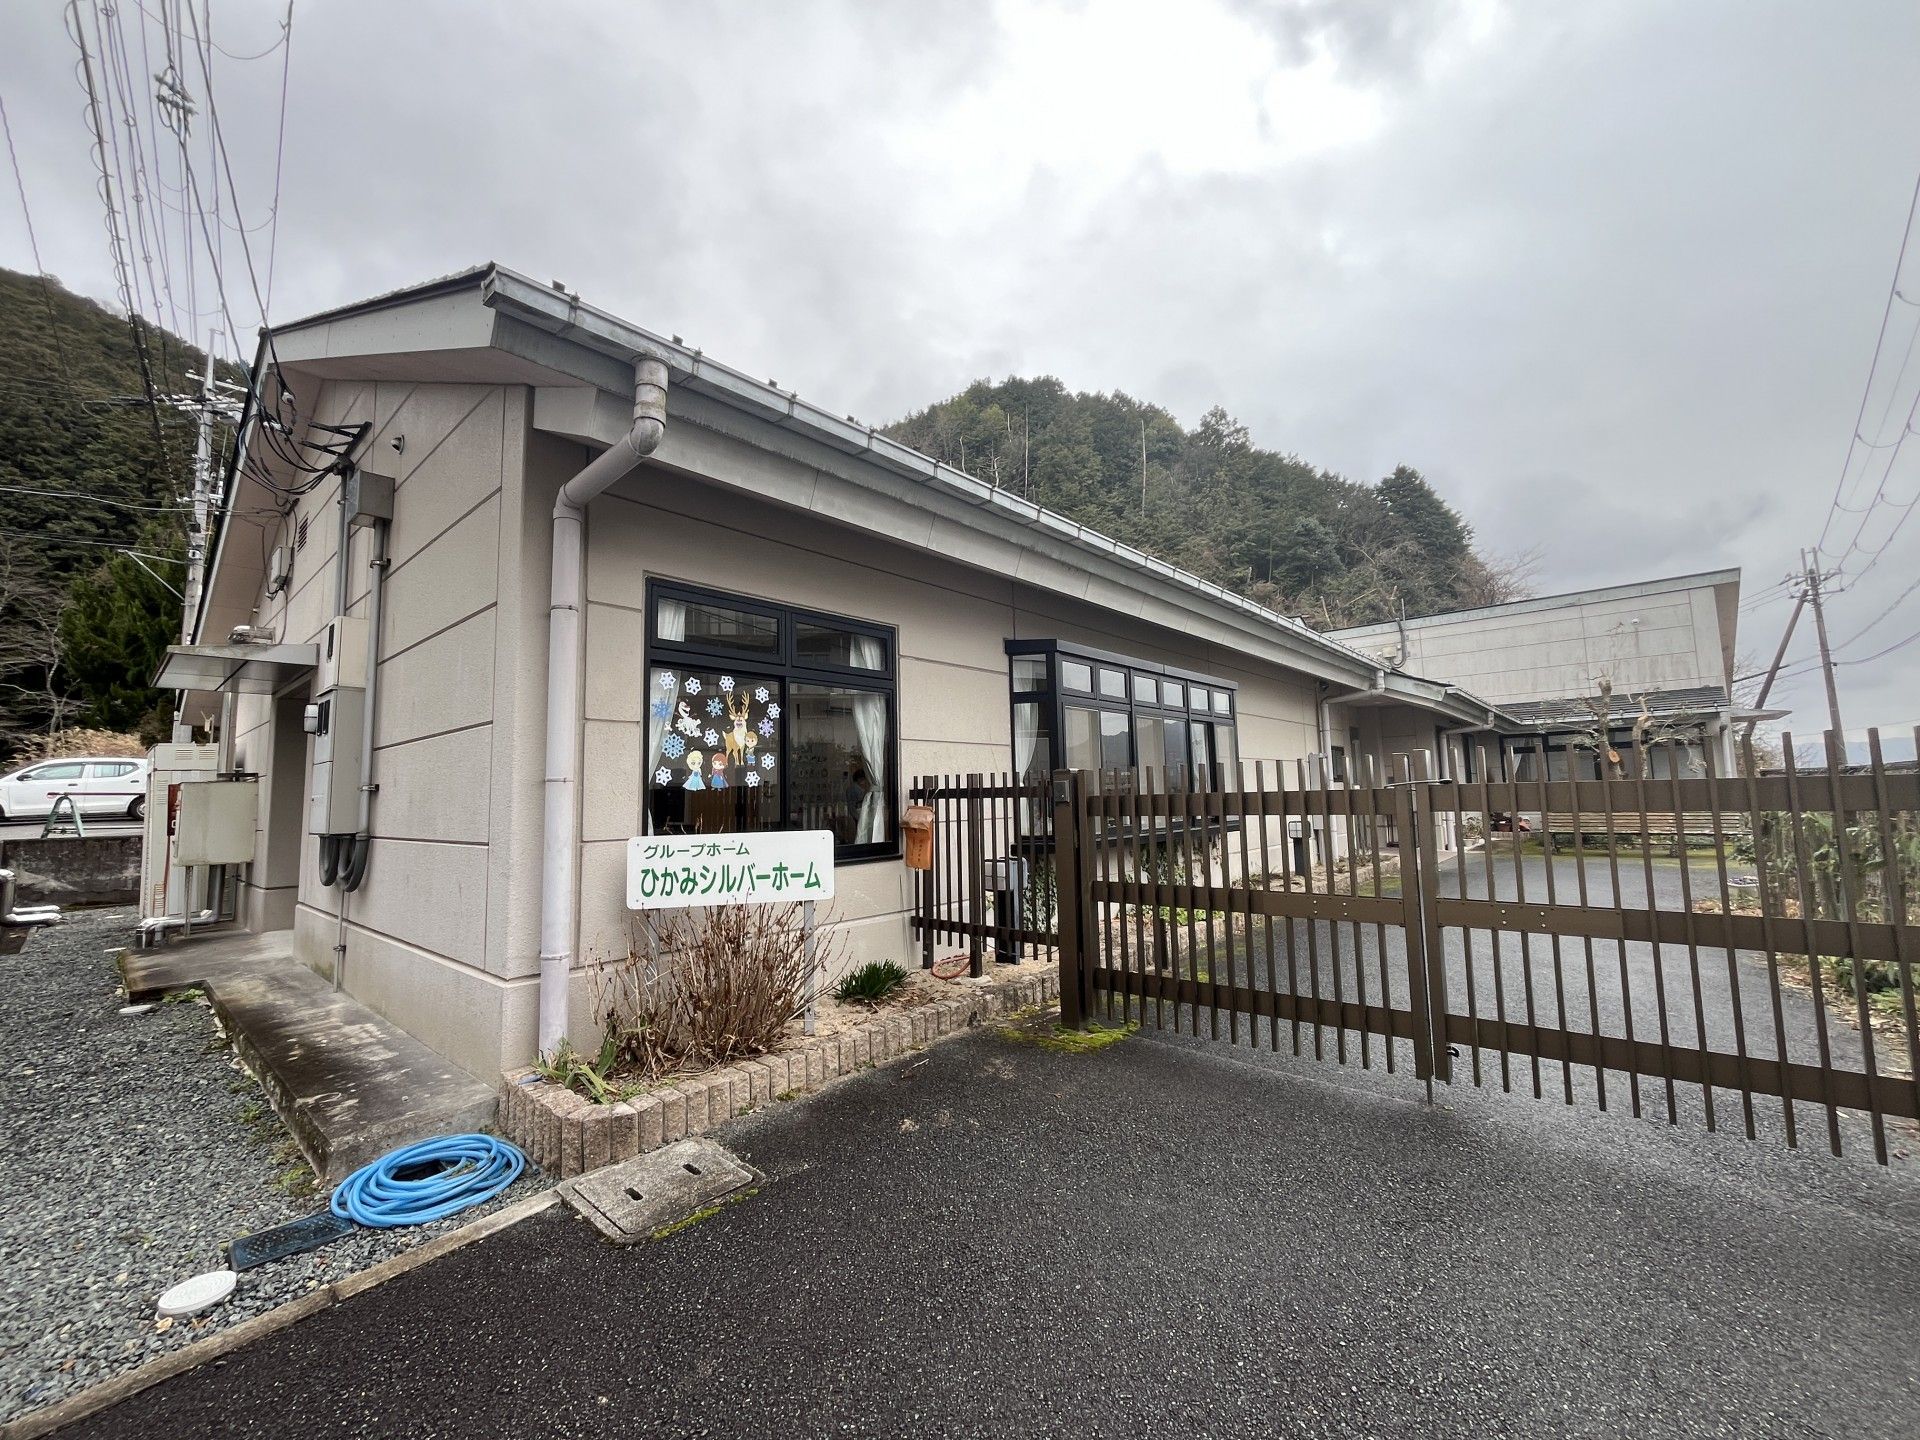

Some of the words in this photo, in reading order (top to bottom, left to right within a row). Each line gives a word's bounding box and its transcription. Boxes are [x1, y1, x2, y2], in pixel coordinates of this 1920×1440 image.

[643, 842, 751, 860] グループホーム
[640, 861, 822, 897] ひかみシルバーホーム
